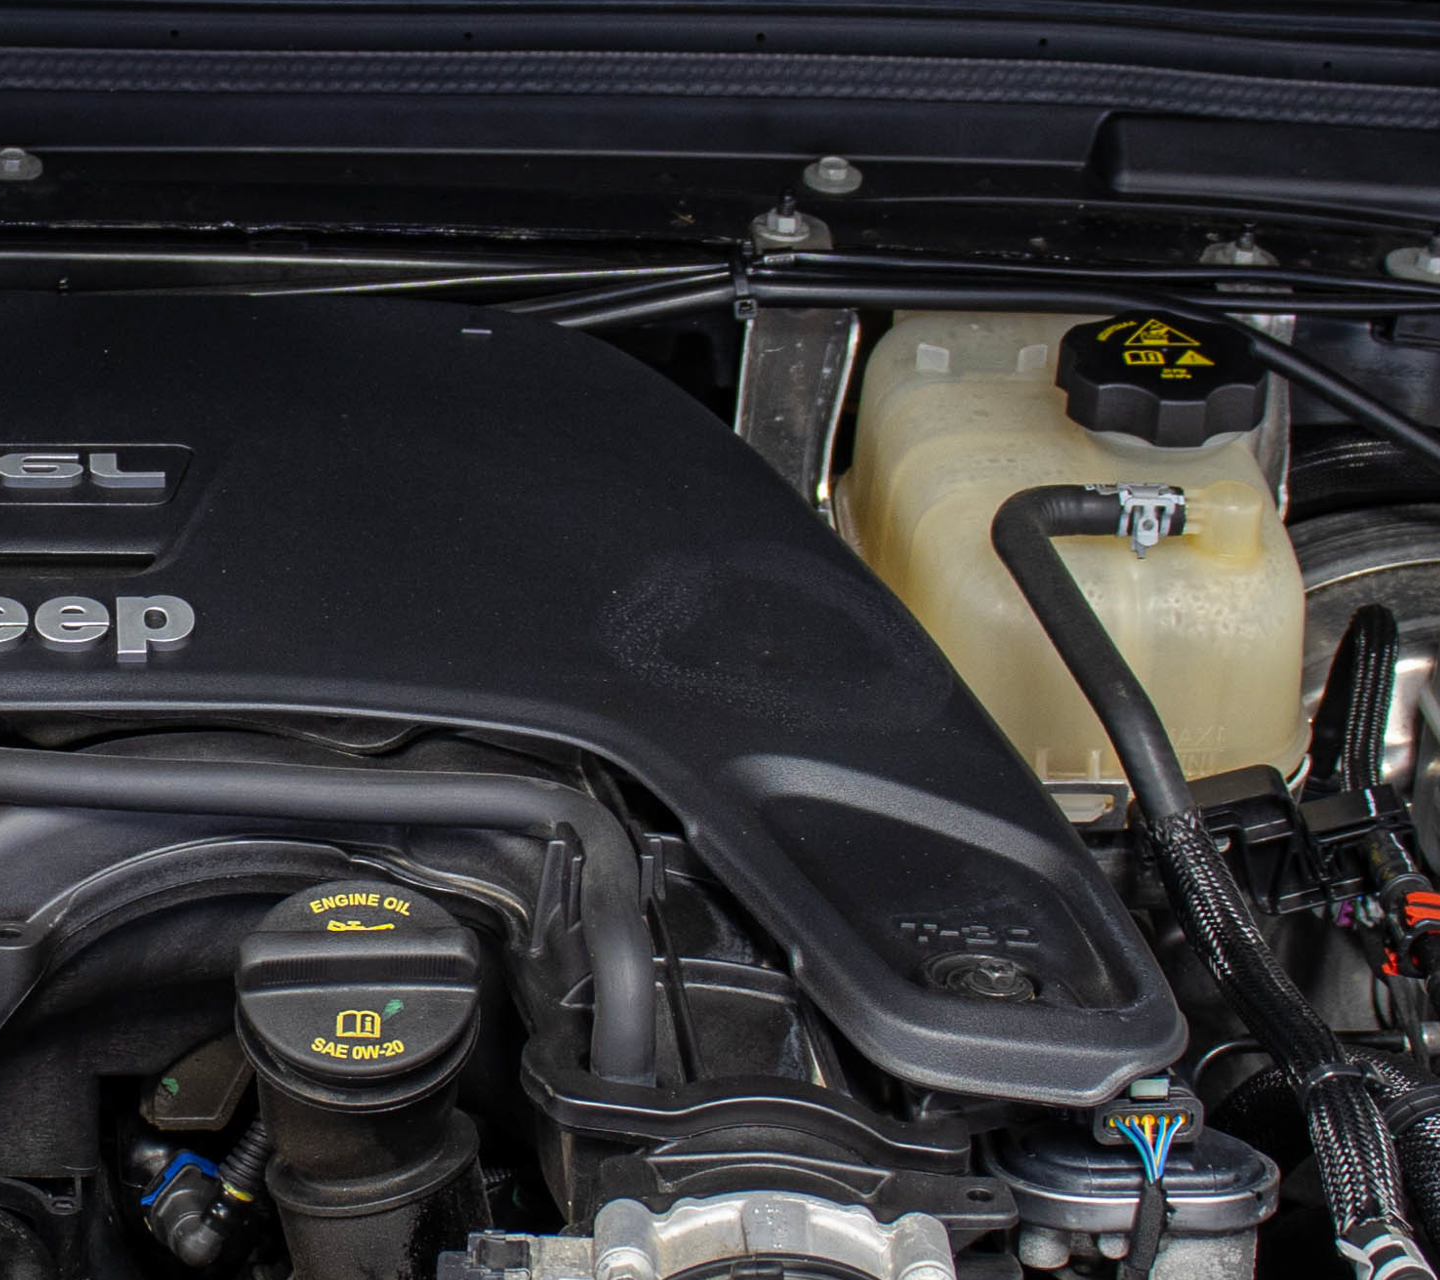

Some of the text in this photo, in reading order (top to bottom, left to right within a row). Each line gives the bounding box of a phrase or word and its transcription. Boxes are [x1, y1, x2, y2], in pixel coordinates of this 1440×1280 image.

[309, 893, 413, 917] ENGINE OIL
[311, 1038, 405, 1060] SAE 0W-20
